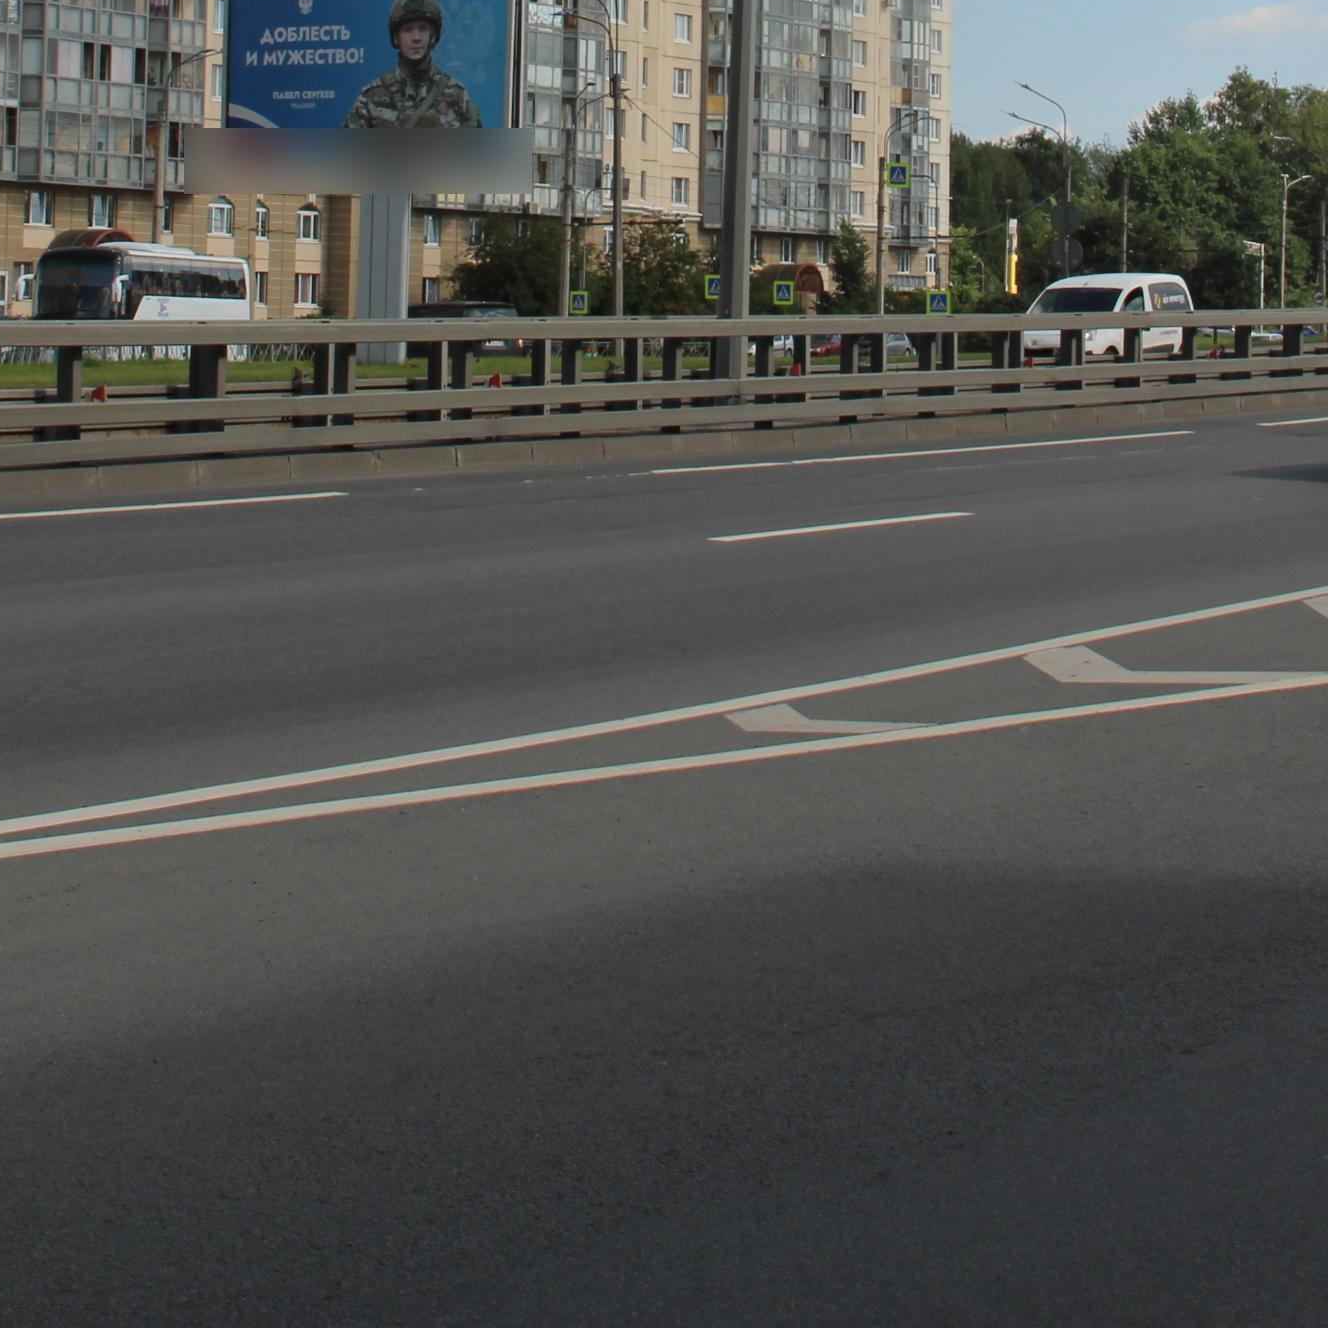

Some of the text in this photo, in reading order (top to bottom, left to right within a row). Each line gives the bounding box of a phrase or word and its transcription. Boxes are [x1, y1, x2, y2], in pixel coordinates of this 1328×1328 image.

[259, 24, 351, 45] ДОБЛЕСТЬ
[245, 48, 364, 66] И МУЖЕСТВО!
[273, 91, 300, 100] ПАВЕЛ
